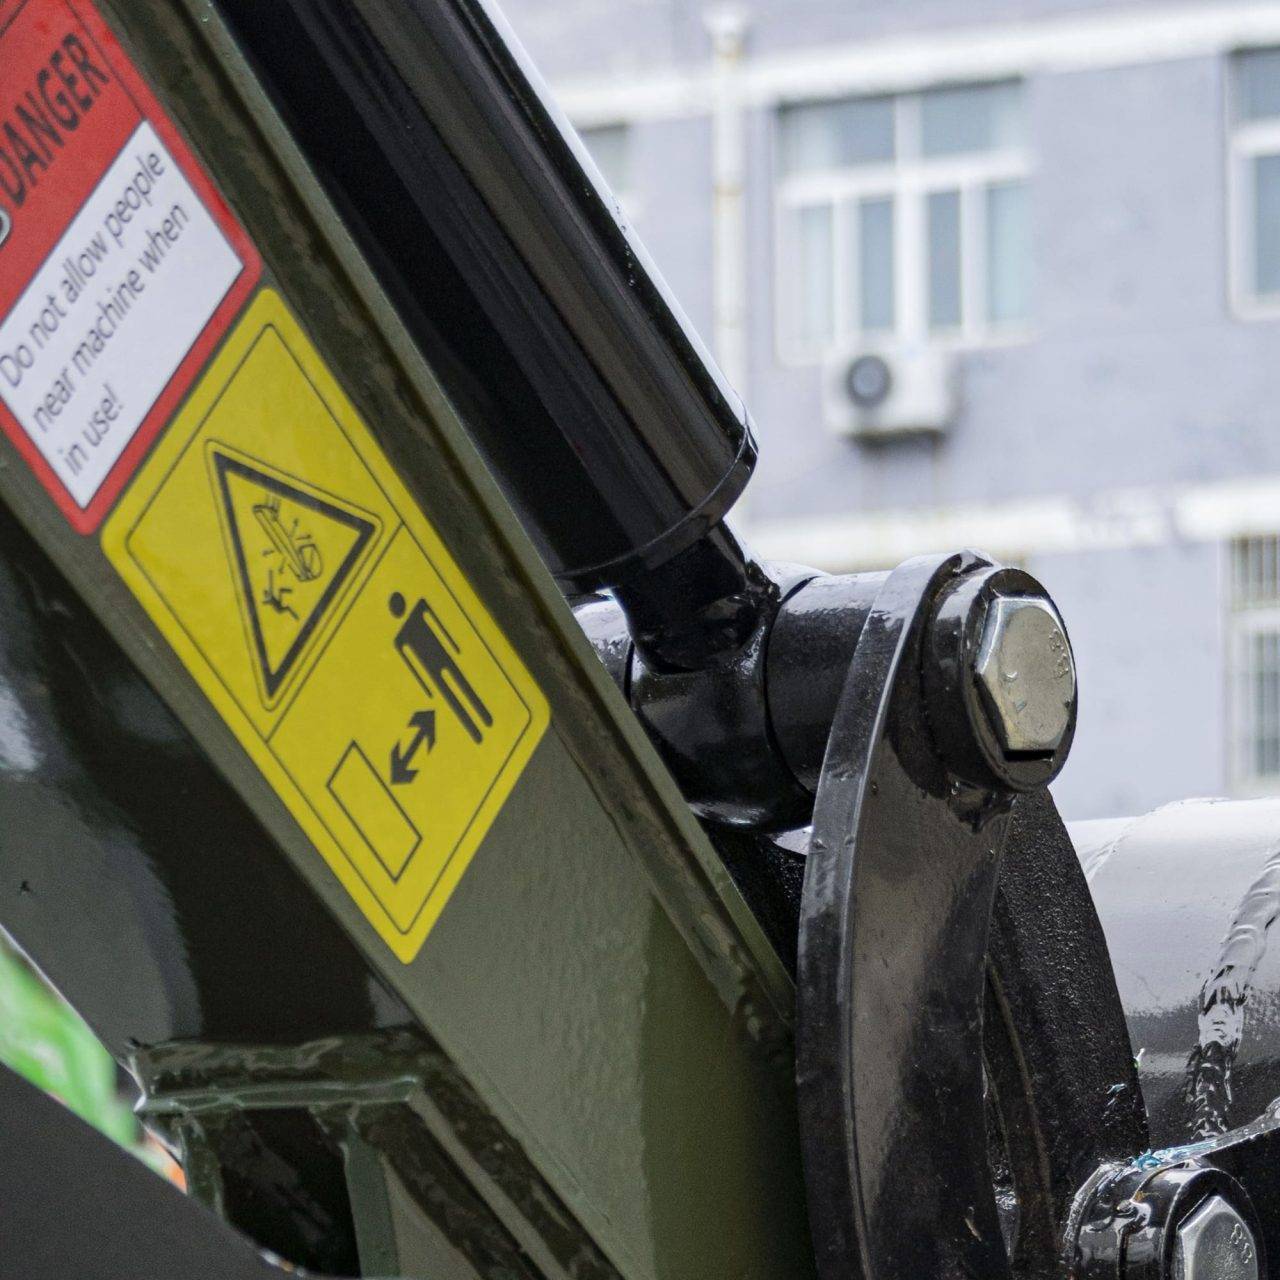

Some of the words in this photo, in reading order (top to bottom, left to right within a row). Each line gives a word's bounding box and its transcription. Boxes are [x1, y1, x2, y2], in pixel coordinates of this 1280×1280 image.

[0, 345, 34, 387] Do
[29, 294, 67, 349] not
[62, 231, 108, 303] allow
[104, 153, 164, 248] people
[34, 367, 76, 432] near
[72, 269, 145, 376] machine
[138, 205, 189, 273] when
[58, 443, 89, 476] in
[82, 383, 123, 447] use!
